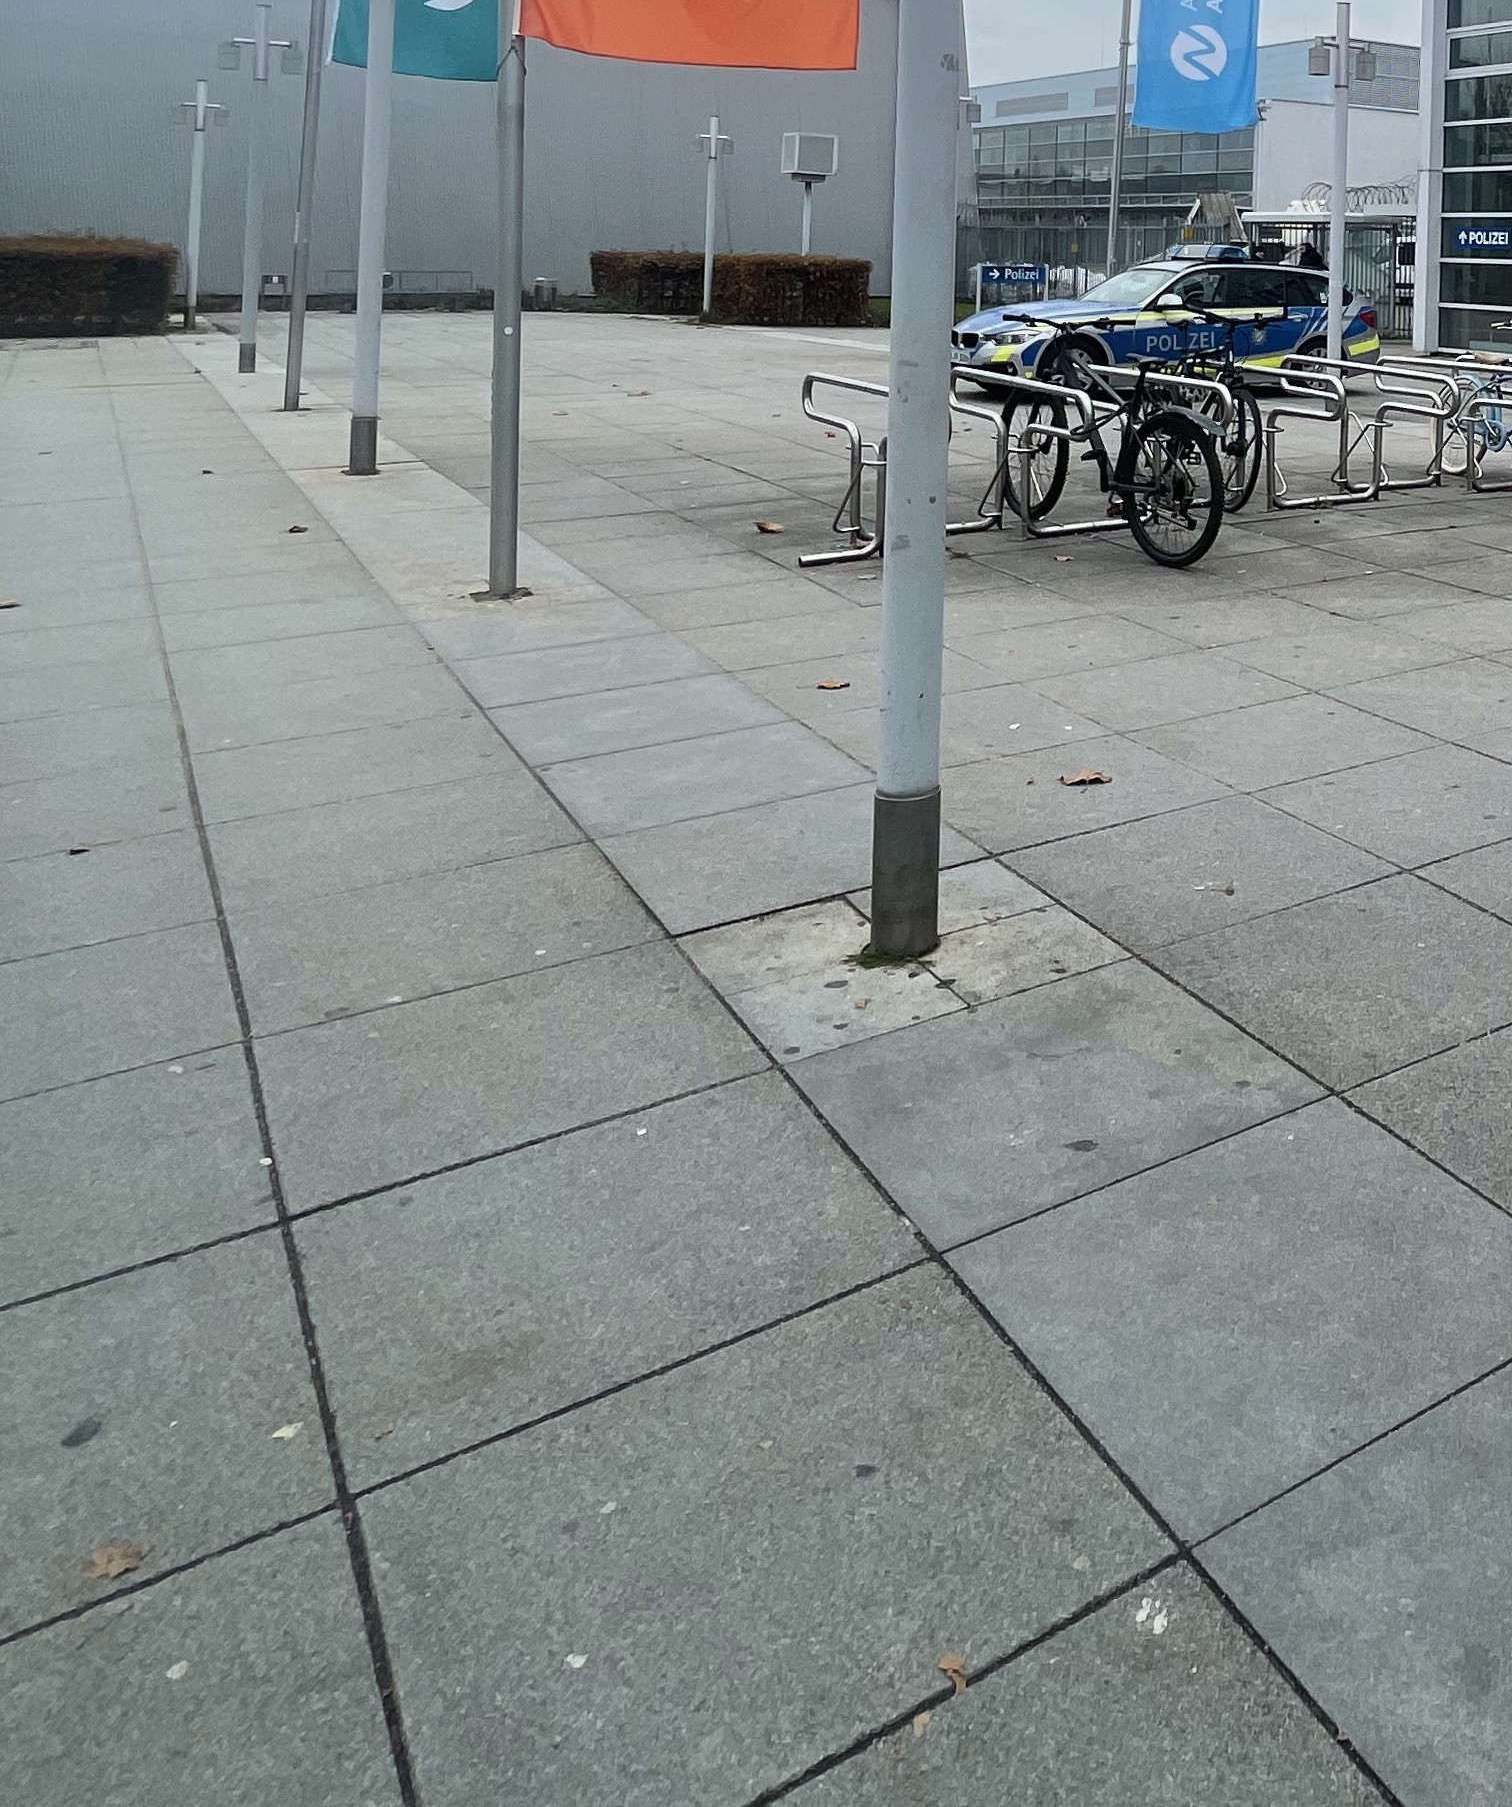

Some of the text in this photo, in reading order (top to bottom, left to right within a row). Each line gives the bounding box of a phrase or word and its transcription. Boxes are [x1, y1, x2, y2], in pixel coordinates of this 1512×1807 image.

[1469, 231, 1509, 245] POLIZEI
[1004, 268, 1039, 280] Polizei
[1146, 331, 1216, 353] POLZEI
